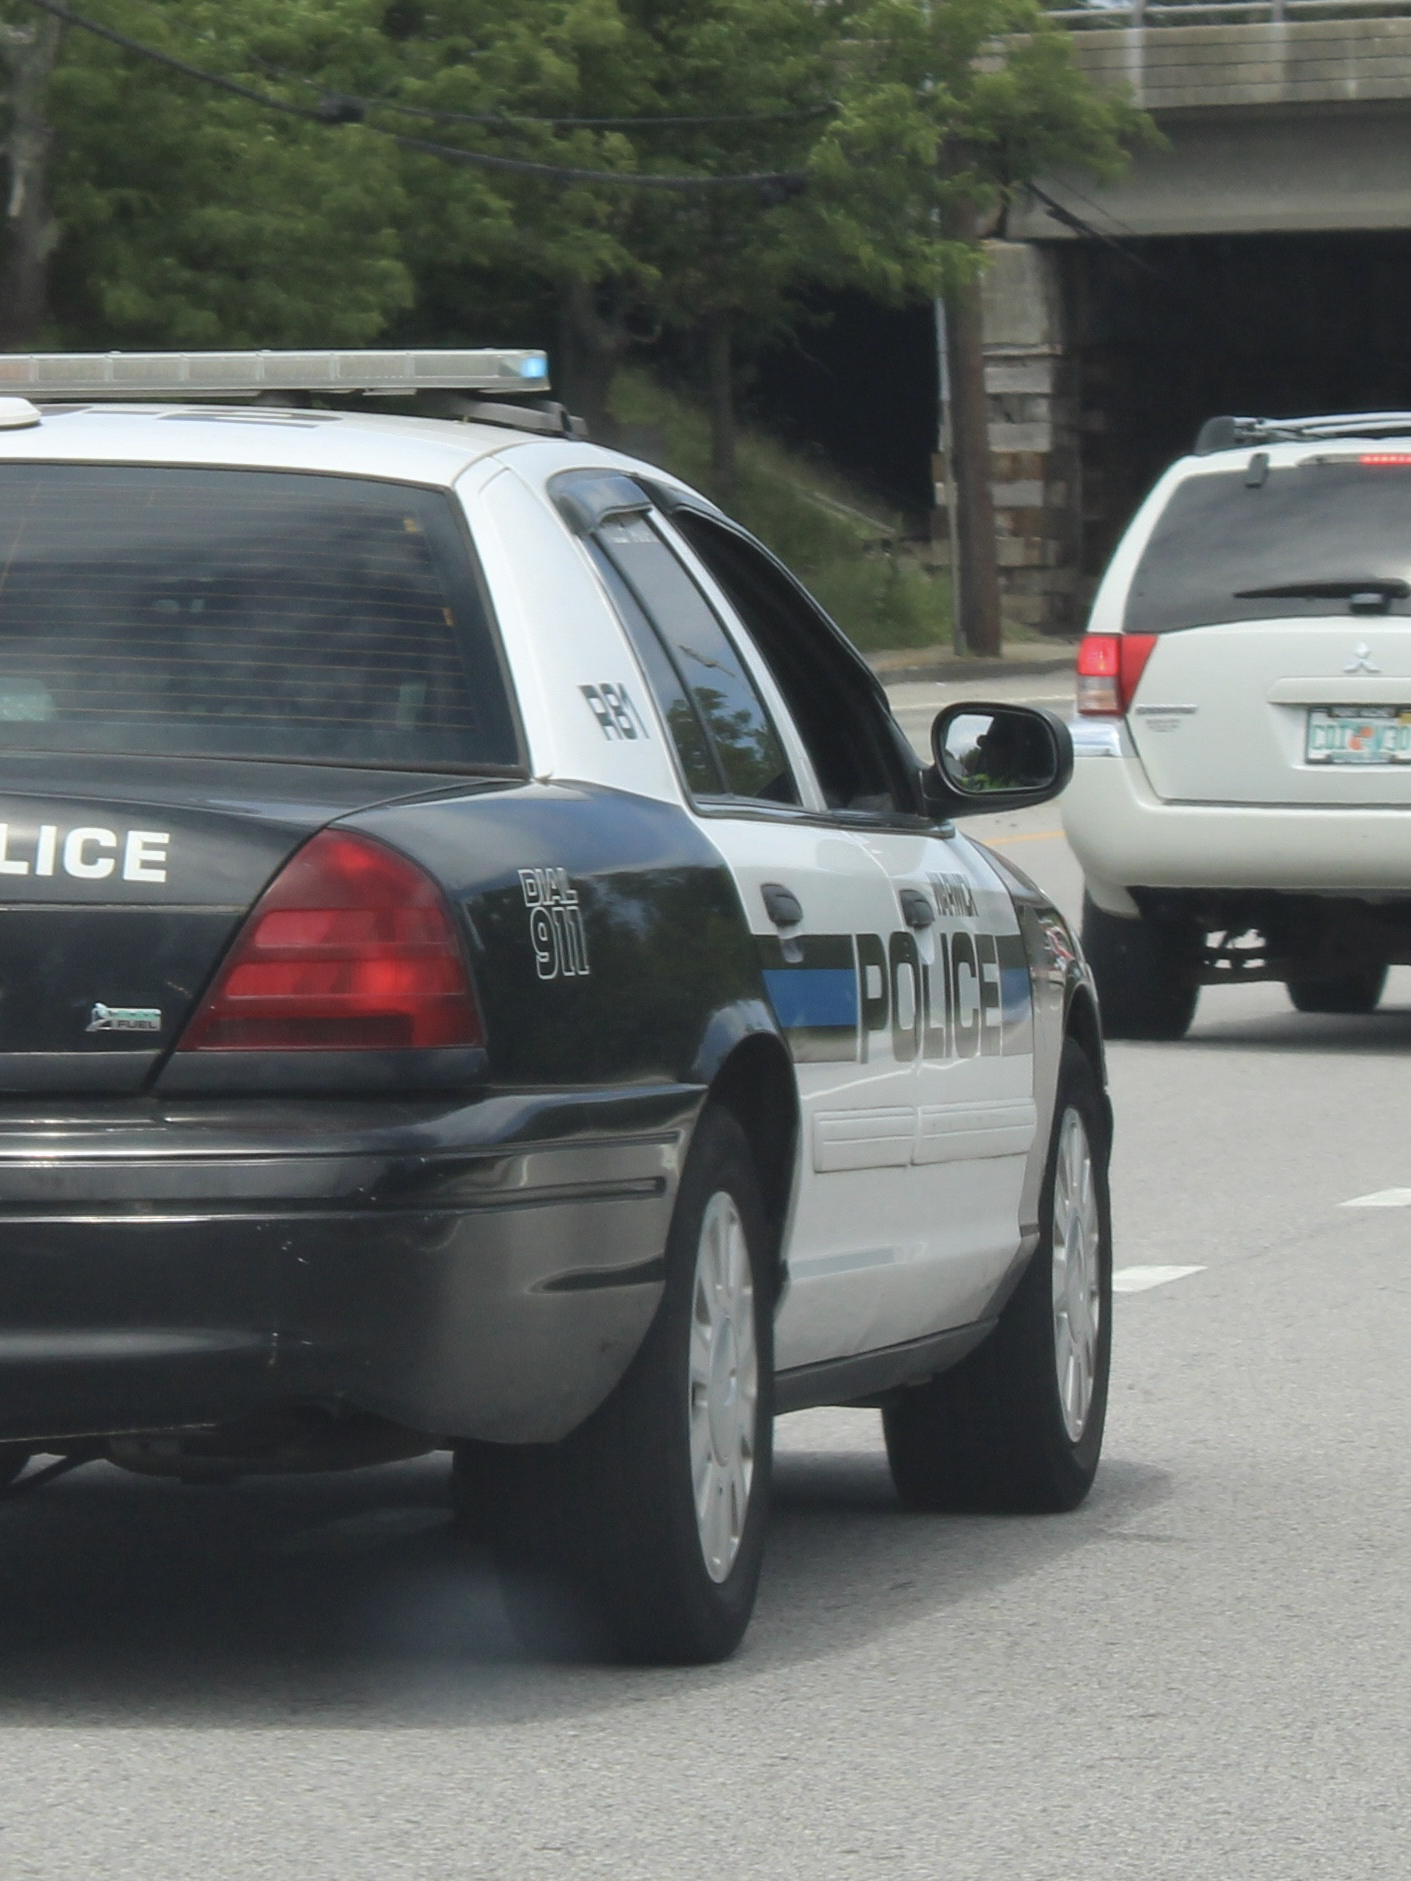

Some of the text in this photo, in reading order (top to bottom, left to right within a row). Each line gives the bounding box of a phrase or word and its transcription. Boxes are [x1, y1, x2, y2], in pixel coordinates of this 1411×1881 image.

[517, 867, 579, 907] DIAL
[530, 906, 590, 979] 911
[855, 931, 1003, 1064] POLICE
